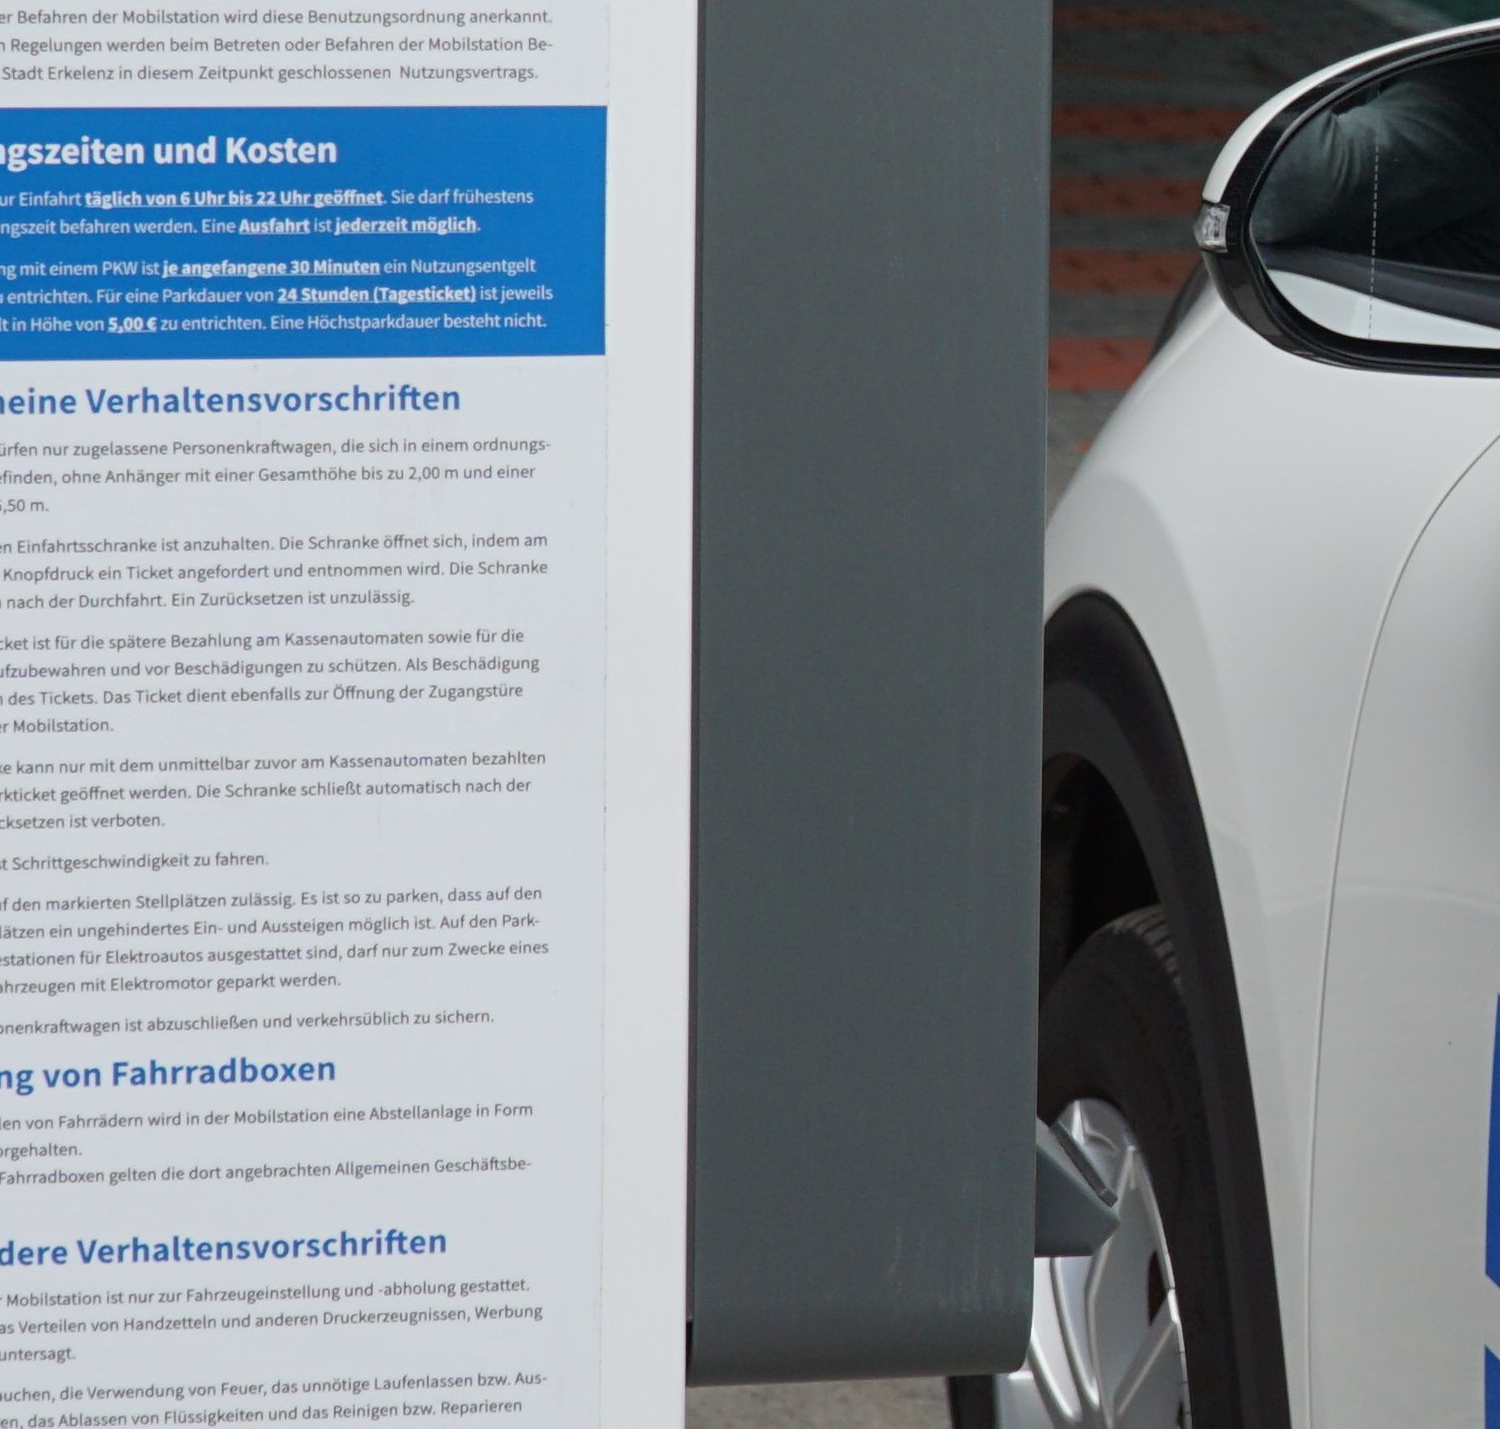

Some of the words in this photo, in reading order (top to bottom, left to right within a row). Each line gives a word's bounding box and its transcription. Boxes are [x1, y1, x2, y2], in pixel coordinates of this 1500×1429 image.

[153, 136, 217, 166] und
[226, 137, 337, 165] Kosten
[19, 191, 82, 207] Einfahrt
[84, 191, 143, 210] täglich
[145, 193, 178, 208] von
[180, 191, 191, 207] 6
[194, 190, 226, 207] Uhr
[228, 190, 254, 207] bis
[256, 191, 277, 207] 22
[280, 190, 312, 207] Uhr
[314, 189, 387, 209] geöffnet.
[392, 189, 415, 204] Sie
[418, 189, 451, 204] darf
[453, 189, 534, 204] frühestens
[59, 219, 130, 234] befahren
[133, 218, 196, 234] werden.
[201, 218, 236, 233] Eine
[238, 217, 310, 235] Ausfahrt
[313, 219, 332, 233] ist
[335, 216, 408, 236] jederzeit
[410, 216, 480, 236] möglich.
[20, 262, 46, 276] mit
[49, 262, 99, 276] einem
[102, 261, 138, 276] PKW
[142, 262, 160, 275] ist
[163, 260, 179, 278] je
[181, 259, 288, 279] angefangene
[290, 259, 312, 276] 30
[313, 258, 381, 276] Minuten
[384, 260, 408, 274] ein
[411, 258, 537, 276] Nutzungsentgelt
[85, 385, 460, 415] Verhaltensvorschriften
[43, 445, 70, 457] nur
[73, 441, 169, 461] zugelassene
[173, 439, 337, 458] Personenkraftwagen,
[341, 439, 365, 454] die
[369, 438, 399, 453] sich
[403, 438, 417, 452] in
[421, 438, 469, 453] einem
[473, 436, 551, 455] ordnungs-
[29, 501, 49, 512] m.
[69, 814, 88, 829] ist
[91, 812, 165, 828] verboten.
[12, 852, 190, 874] Schrittgeschwindigkeit
[193, 855, 211, 867] zu
[214, 851, 269, 866] fahren.
[42, 1068, 101, 1089] von
[112, 1058, 335, 1087] Fahrradboxen
[76, 1229, 446, 1265] Verhaltensvorschriften
